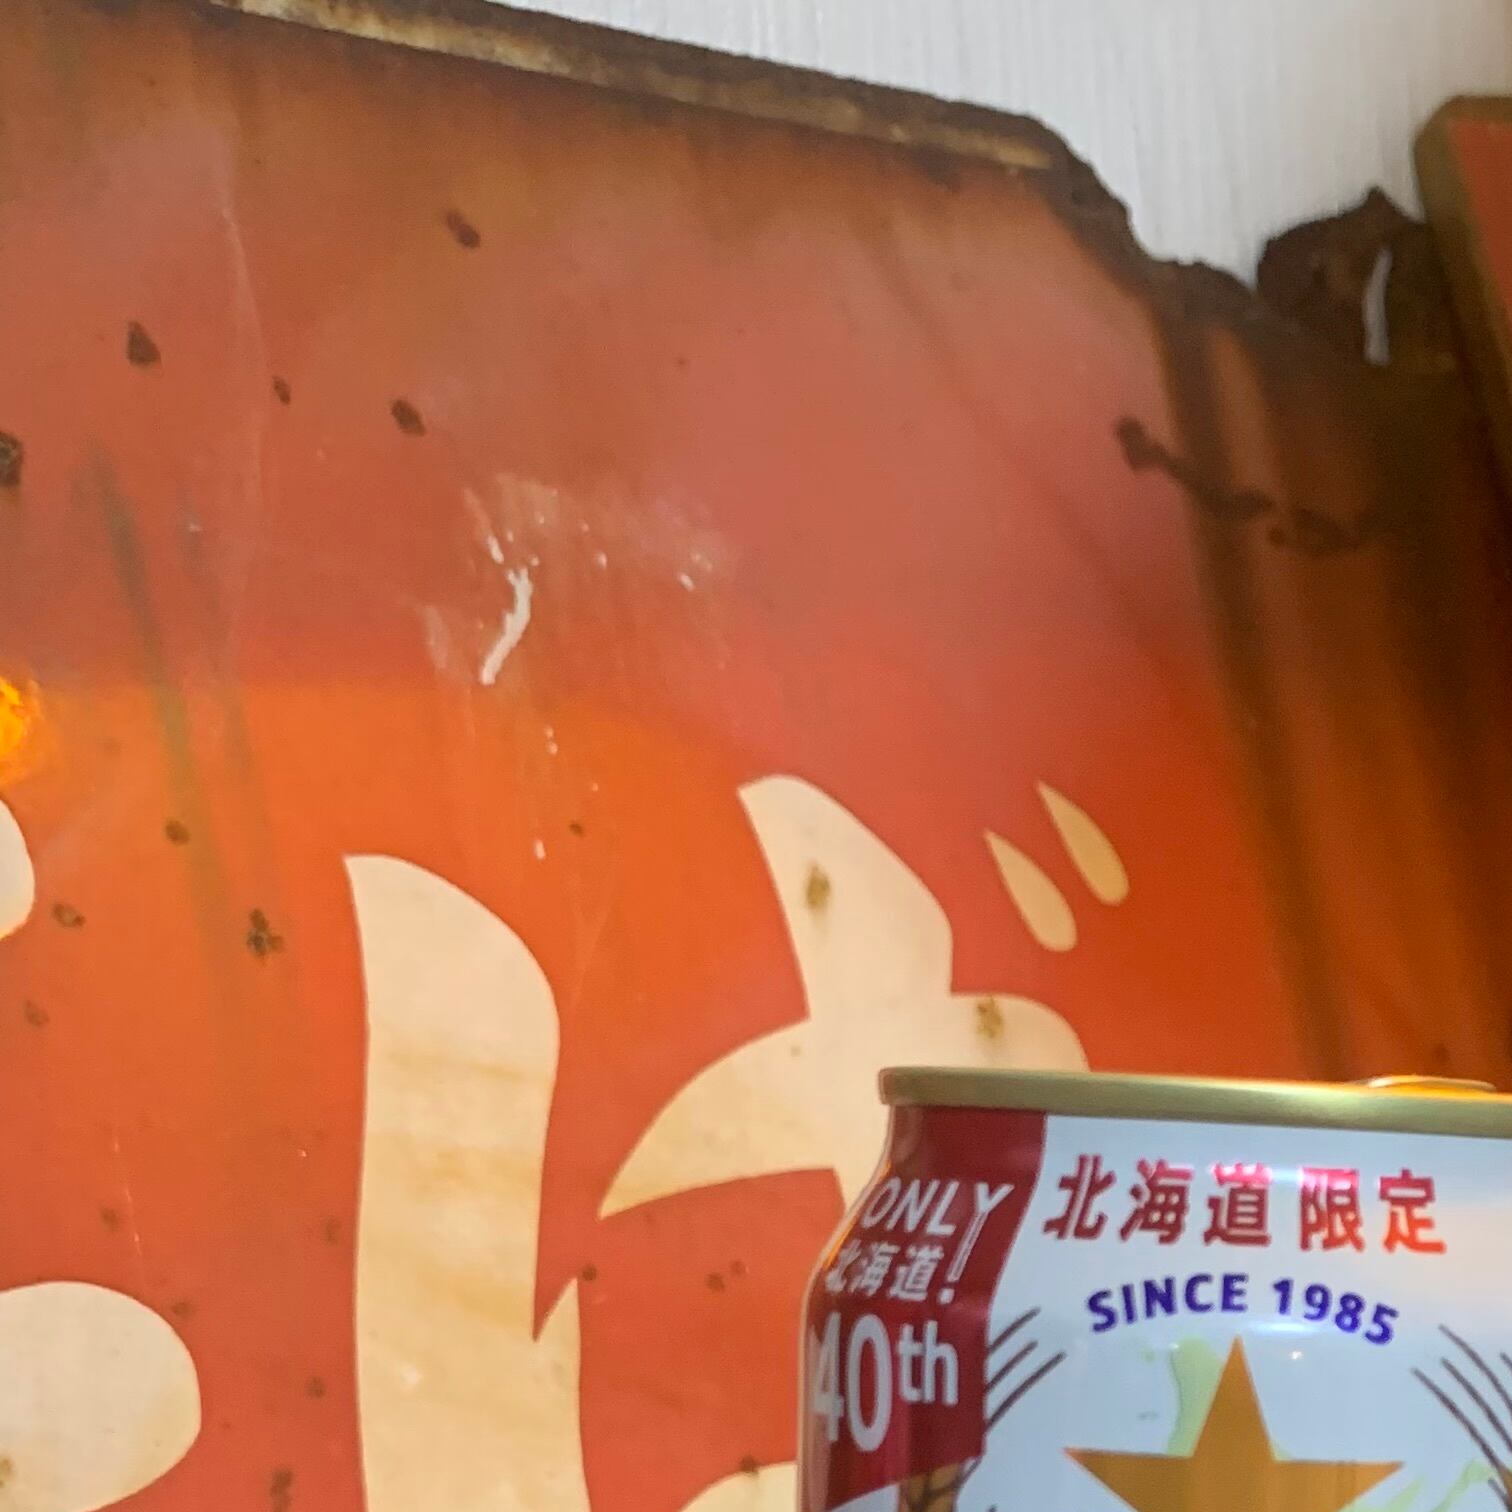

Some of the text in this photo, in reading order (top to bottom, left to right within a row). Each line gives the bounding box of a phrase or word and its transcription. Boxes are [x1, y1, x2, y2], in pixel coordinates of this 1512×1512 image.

[858, 1176, 1016, 1240] ONLY
[1087, 1273, 1400, 1345] SINCE 1985
[808, 1310, 960, 1452] 40th
